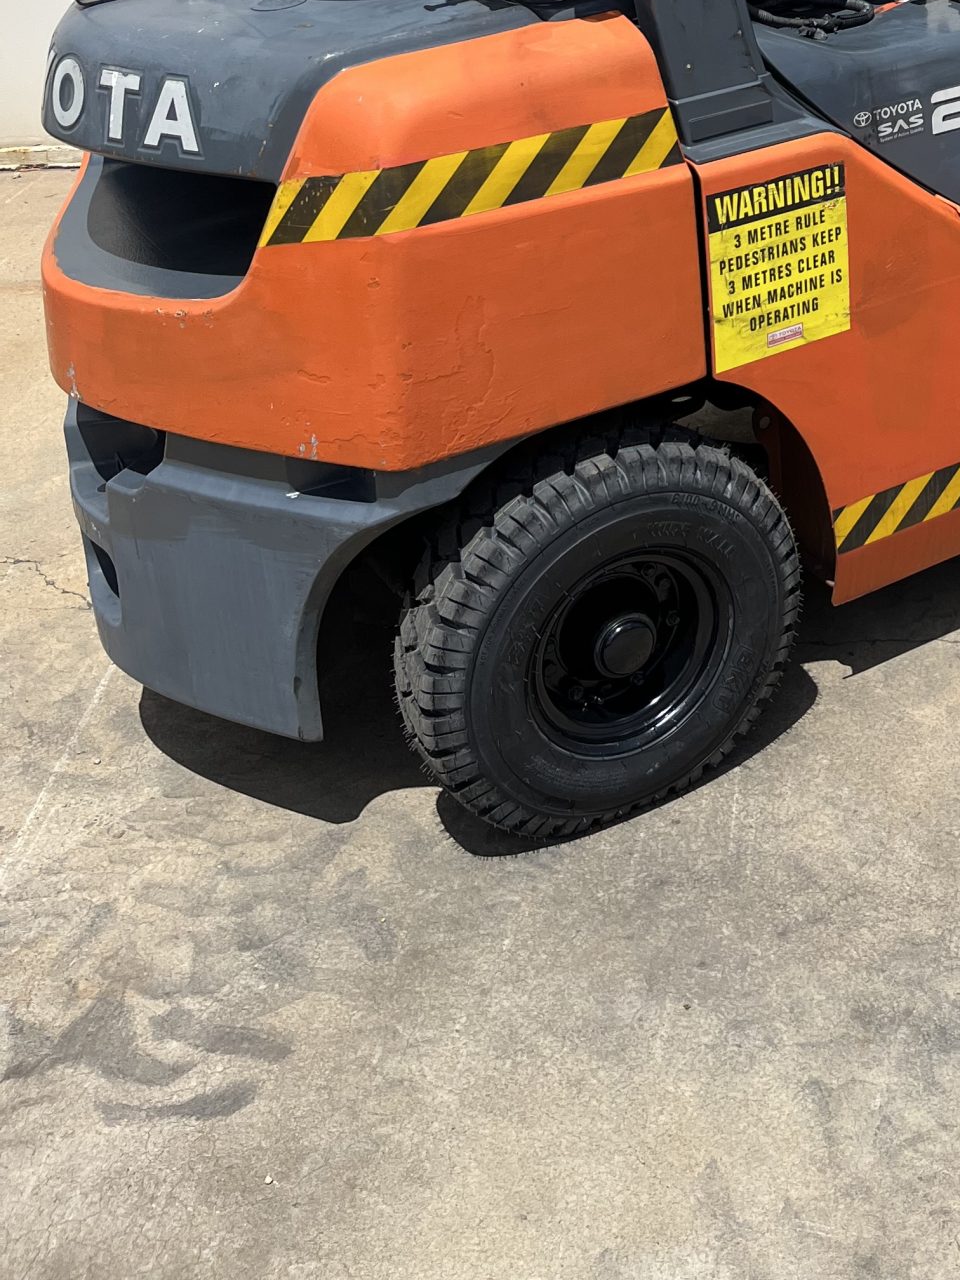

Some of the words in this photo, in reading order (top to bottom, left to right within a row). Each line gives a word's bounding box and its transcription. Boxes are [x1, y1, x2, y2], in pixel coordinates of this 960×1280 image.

[49, 50, 199, 152] OTA
[873, 99, 922, 120] TOYOTA
[878, 113, 924, 137] SAS
[715, 166, 840, 225] WARNING!!
[719, 237, 807, 275] PEDESTRIANS
[812, 227, 842, 247] KEEP
[734, 234, 742, 249] 3
[748, 223, 790, 245] METRE
[795, 209, 826, 231] RULE
[722, 296, 762, 319] WHEN
[767, 275, 826, 303] MACHINE
[830, 269, 843, 285] IS
[728, 280, 736, 295] 3
[742, 263, 792, 291] METRES
[798, 250, 836, 273] CLEAR
[749, 297, 820, 332] OPERATING
